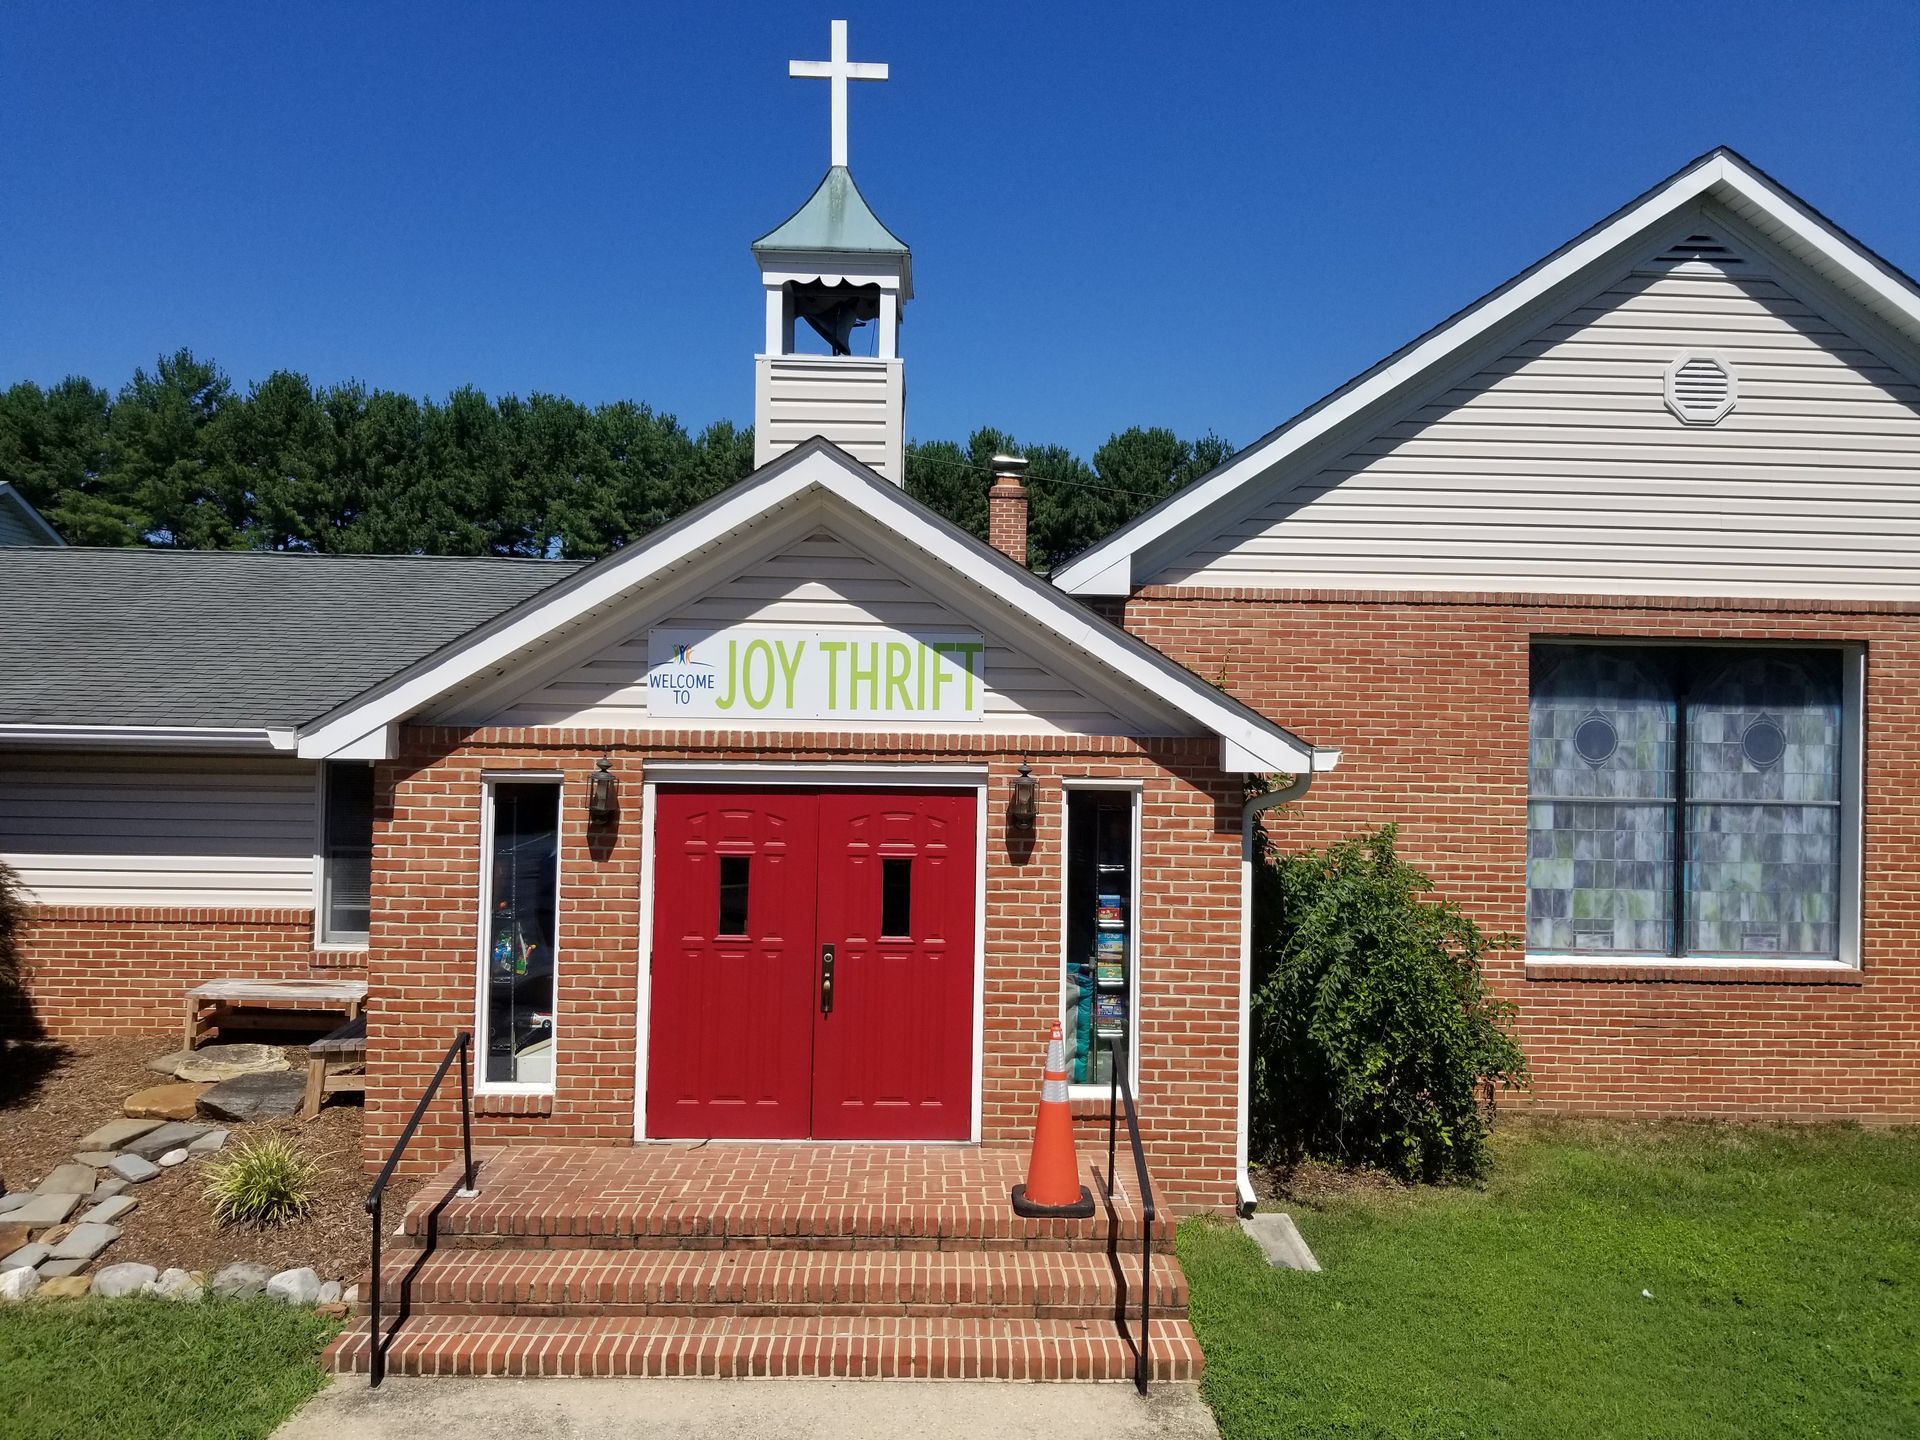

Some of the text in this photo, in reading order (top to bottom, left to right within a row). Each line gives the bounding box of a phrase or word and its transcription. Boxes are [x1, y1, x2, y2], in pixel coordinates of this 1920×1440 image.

[649, 673, 715, 689] WELCOME
[715, 639, 983, 711] JOY THRIFT
[673, 689, 690, 705] TO
